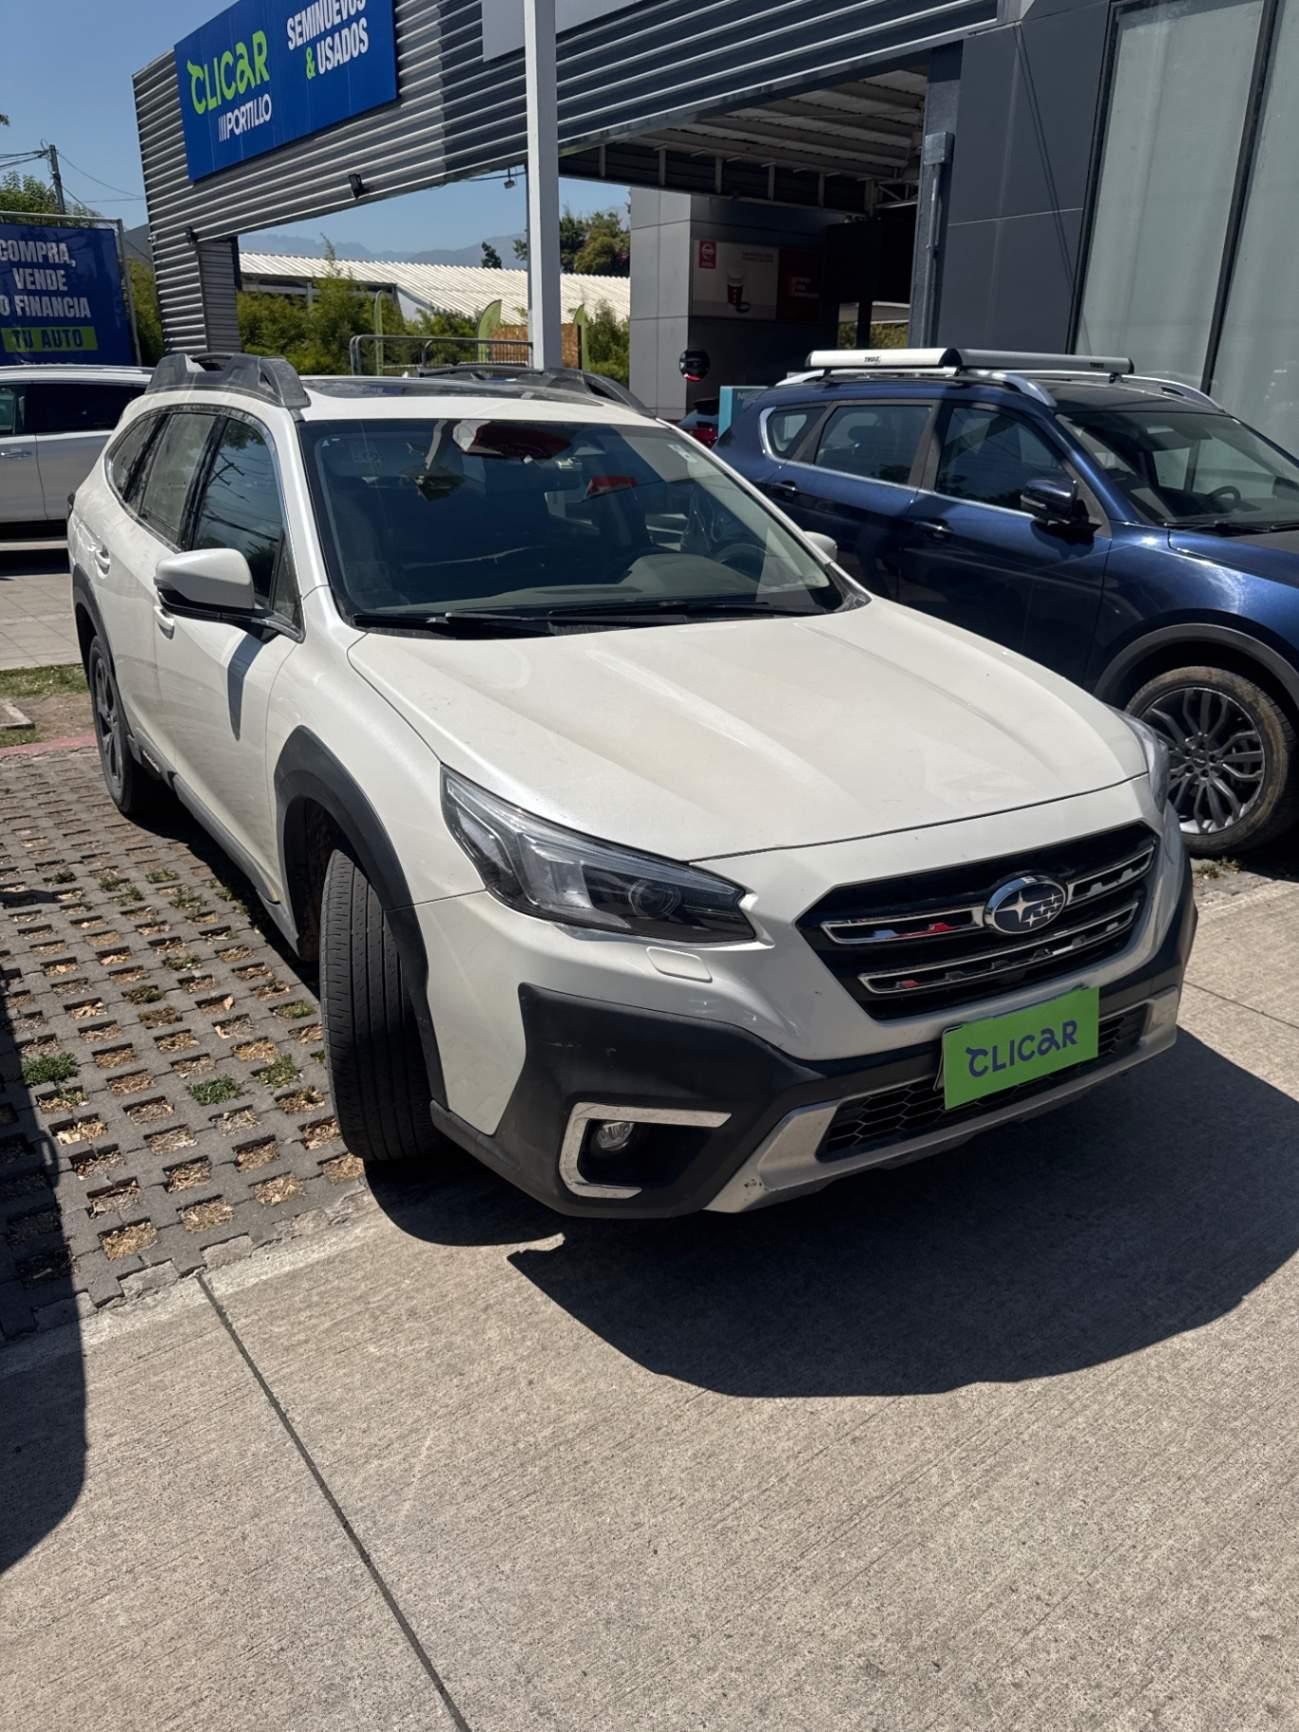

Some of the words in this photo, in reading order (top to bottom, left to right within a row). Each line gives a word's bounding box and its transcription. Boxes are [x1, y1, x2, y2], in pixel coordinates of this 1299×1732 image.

[287, 0, 366, 50] SEMINUEV
[306, 47, 316, 80] &
[316, 17, 369, 75] USADOS
[226, 94, 272, 139] PORTILLO
[0, 239, 76, 267] COMPRA,
[12, 267, 68, 291] VENDE
[0, 294, 11, 316] O
[14, 295, 91, 318] FINANCIA
[11, 329, 34, 349] TU
[40, 329, 83, 348] AUTO
